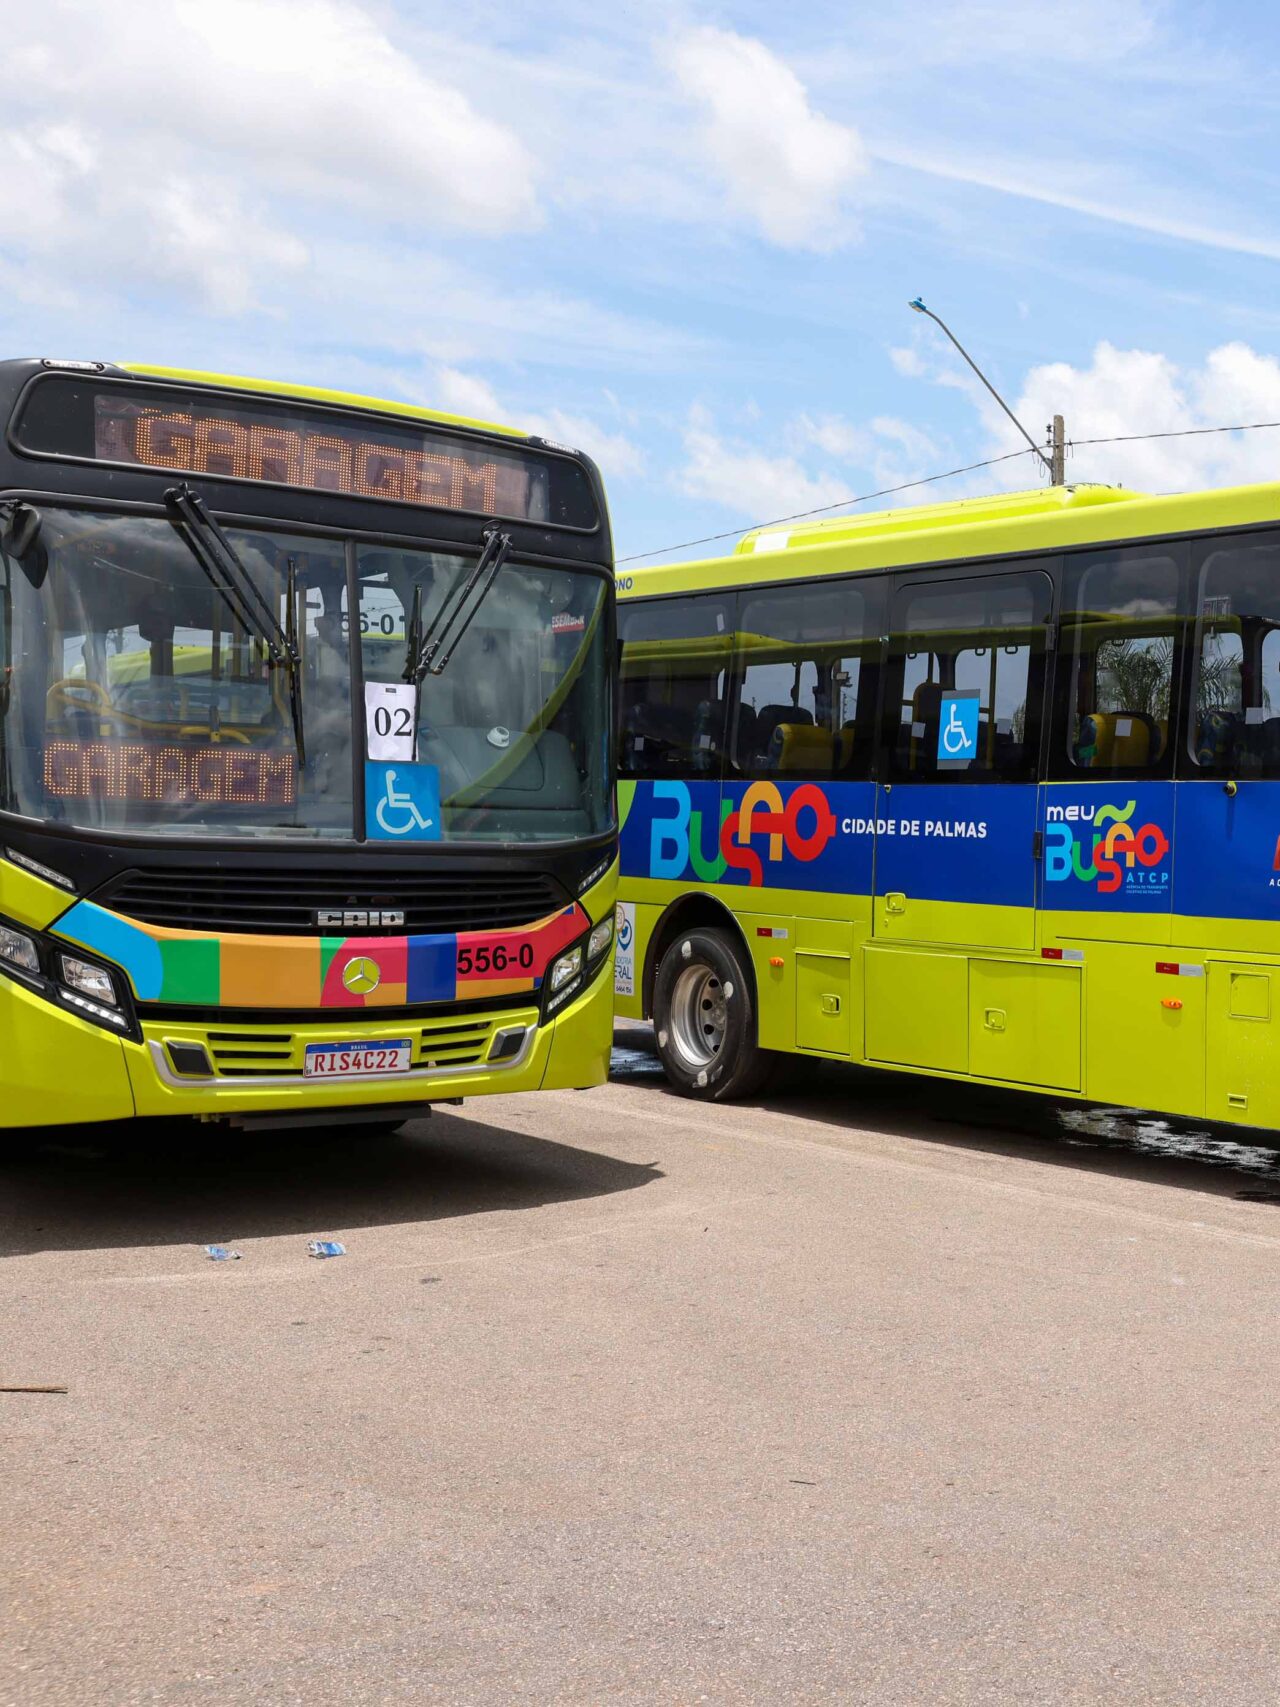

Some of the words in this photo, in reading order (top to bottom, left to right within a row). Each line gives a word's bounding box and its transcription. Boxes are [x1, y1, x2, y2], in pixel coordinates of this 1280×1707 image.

[135, 408, 497, 514] GARAGEM
[374, 706, 413, 738] 02
[44, 743, 294, 803] GARAGEM
[841, 818, 896, 836] CIDADE
[900, 820, 920, 837] DE
[924, 820, 988, 839] PALMAS
[1269, 878, 1275, 887] A
[317, 911, 405, 926] CAIO
[456, 943, 534, 975] 556-0
[313, 1049, 399, 1073] RIS4C22
